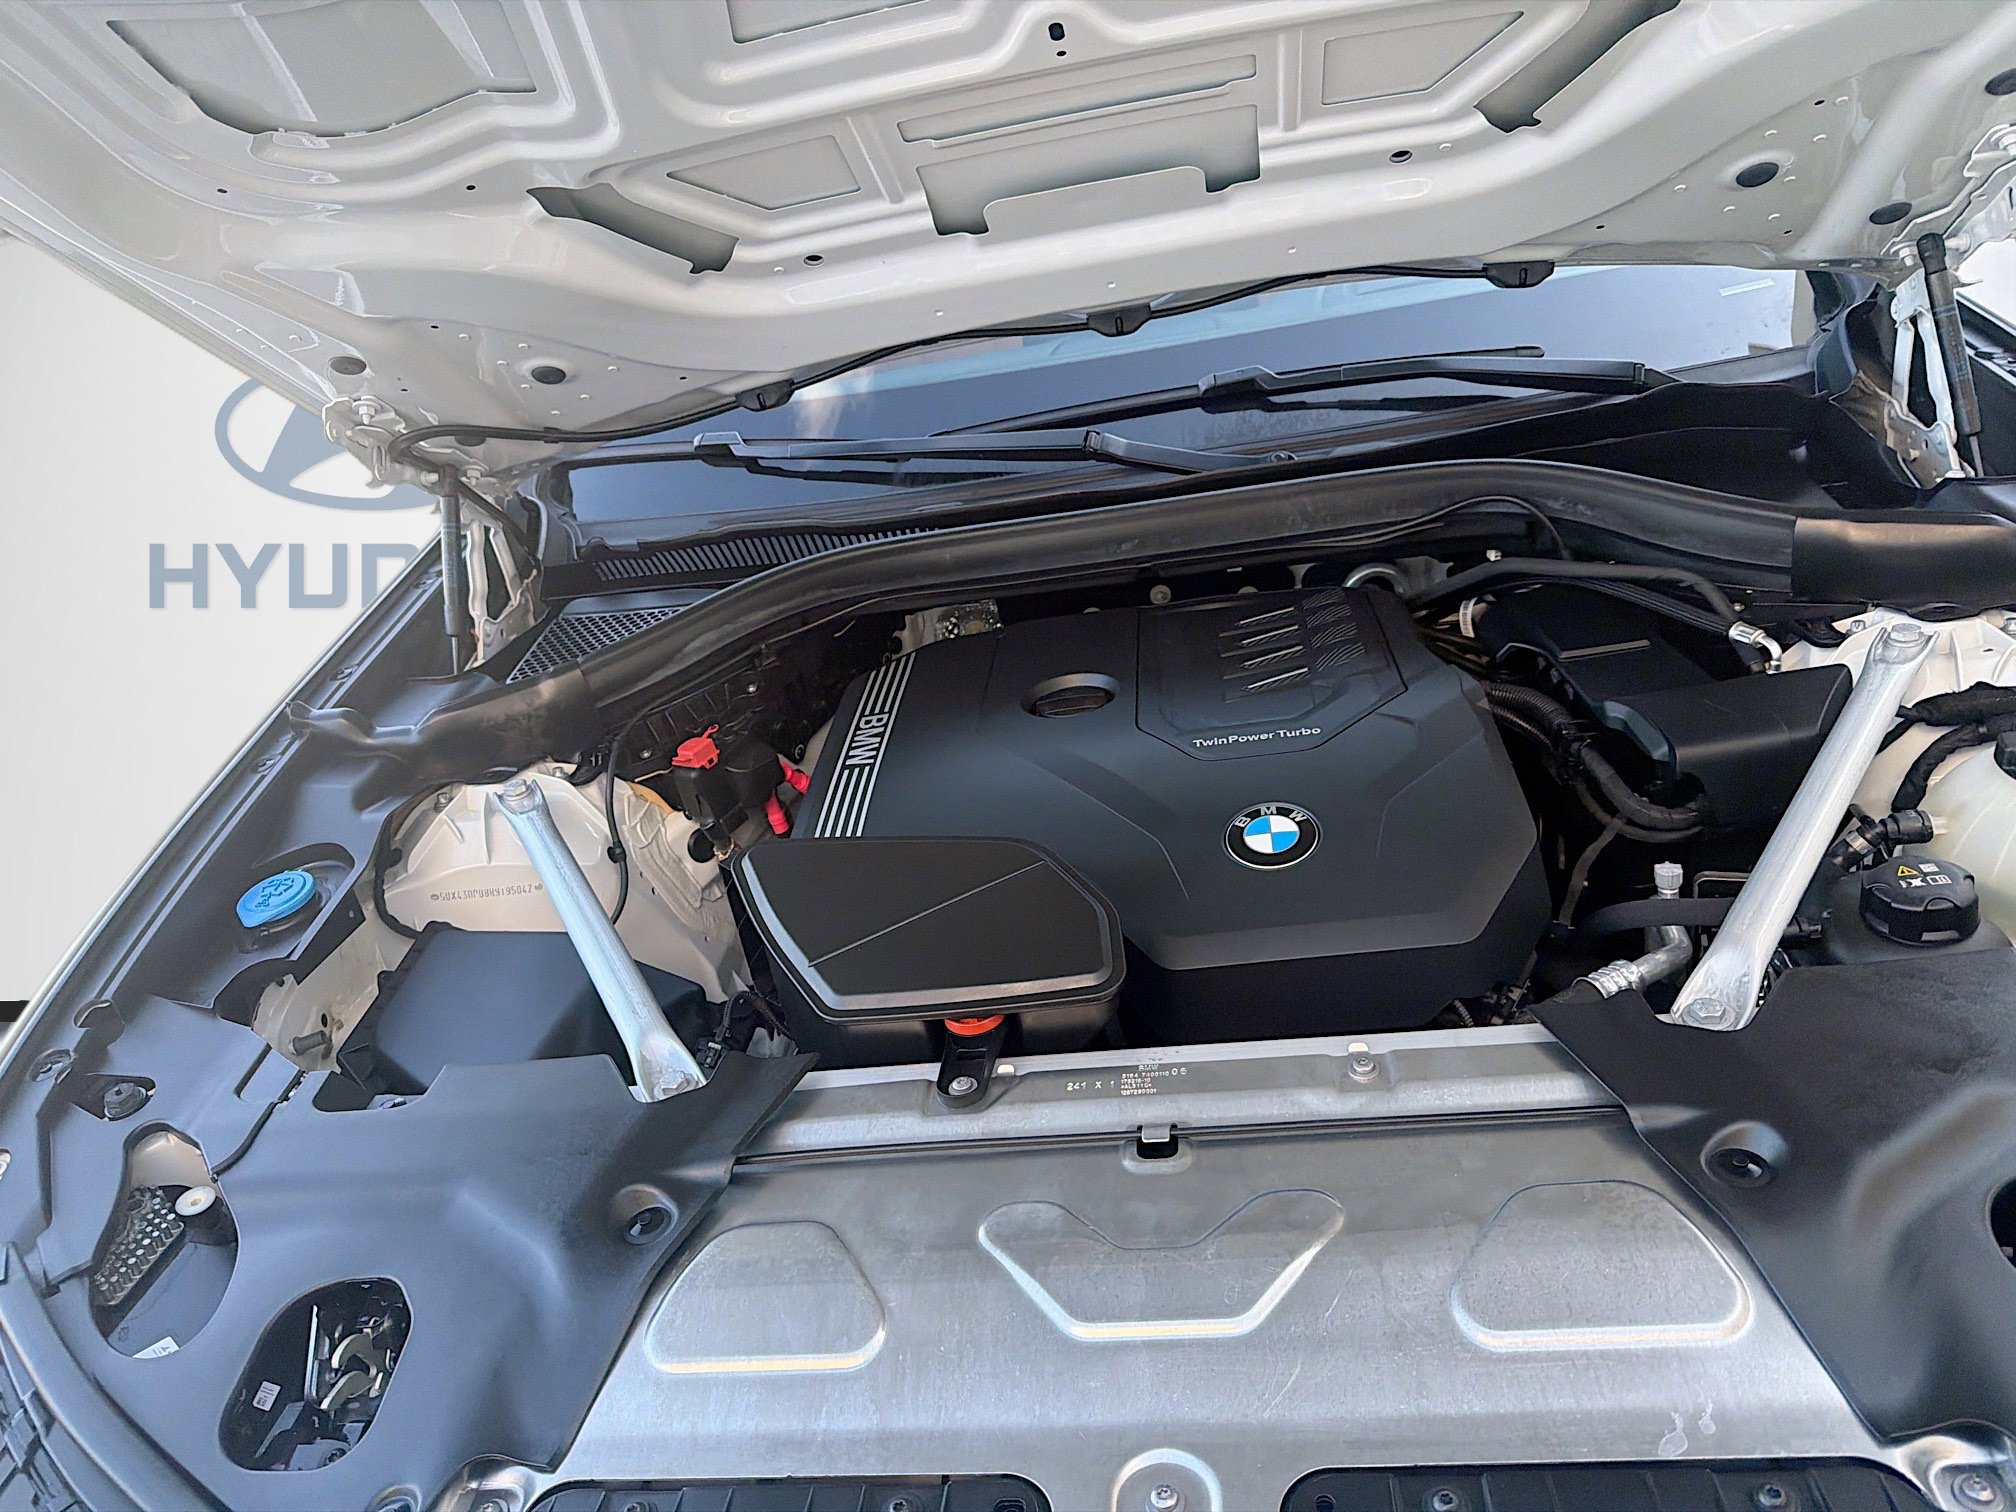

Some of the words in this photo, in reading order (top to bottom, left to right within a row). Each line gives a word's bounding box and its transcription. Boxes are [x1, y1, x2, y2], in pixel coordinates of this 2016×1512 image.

[845, 713, 890, 765] BMW
[1192, 732, 1275, 748] TwinPower
[1276, 727, 1322, 739] Turbo
[1234, 805, 1308, 828] BMW
